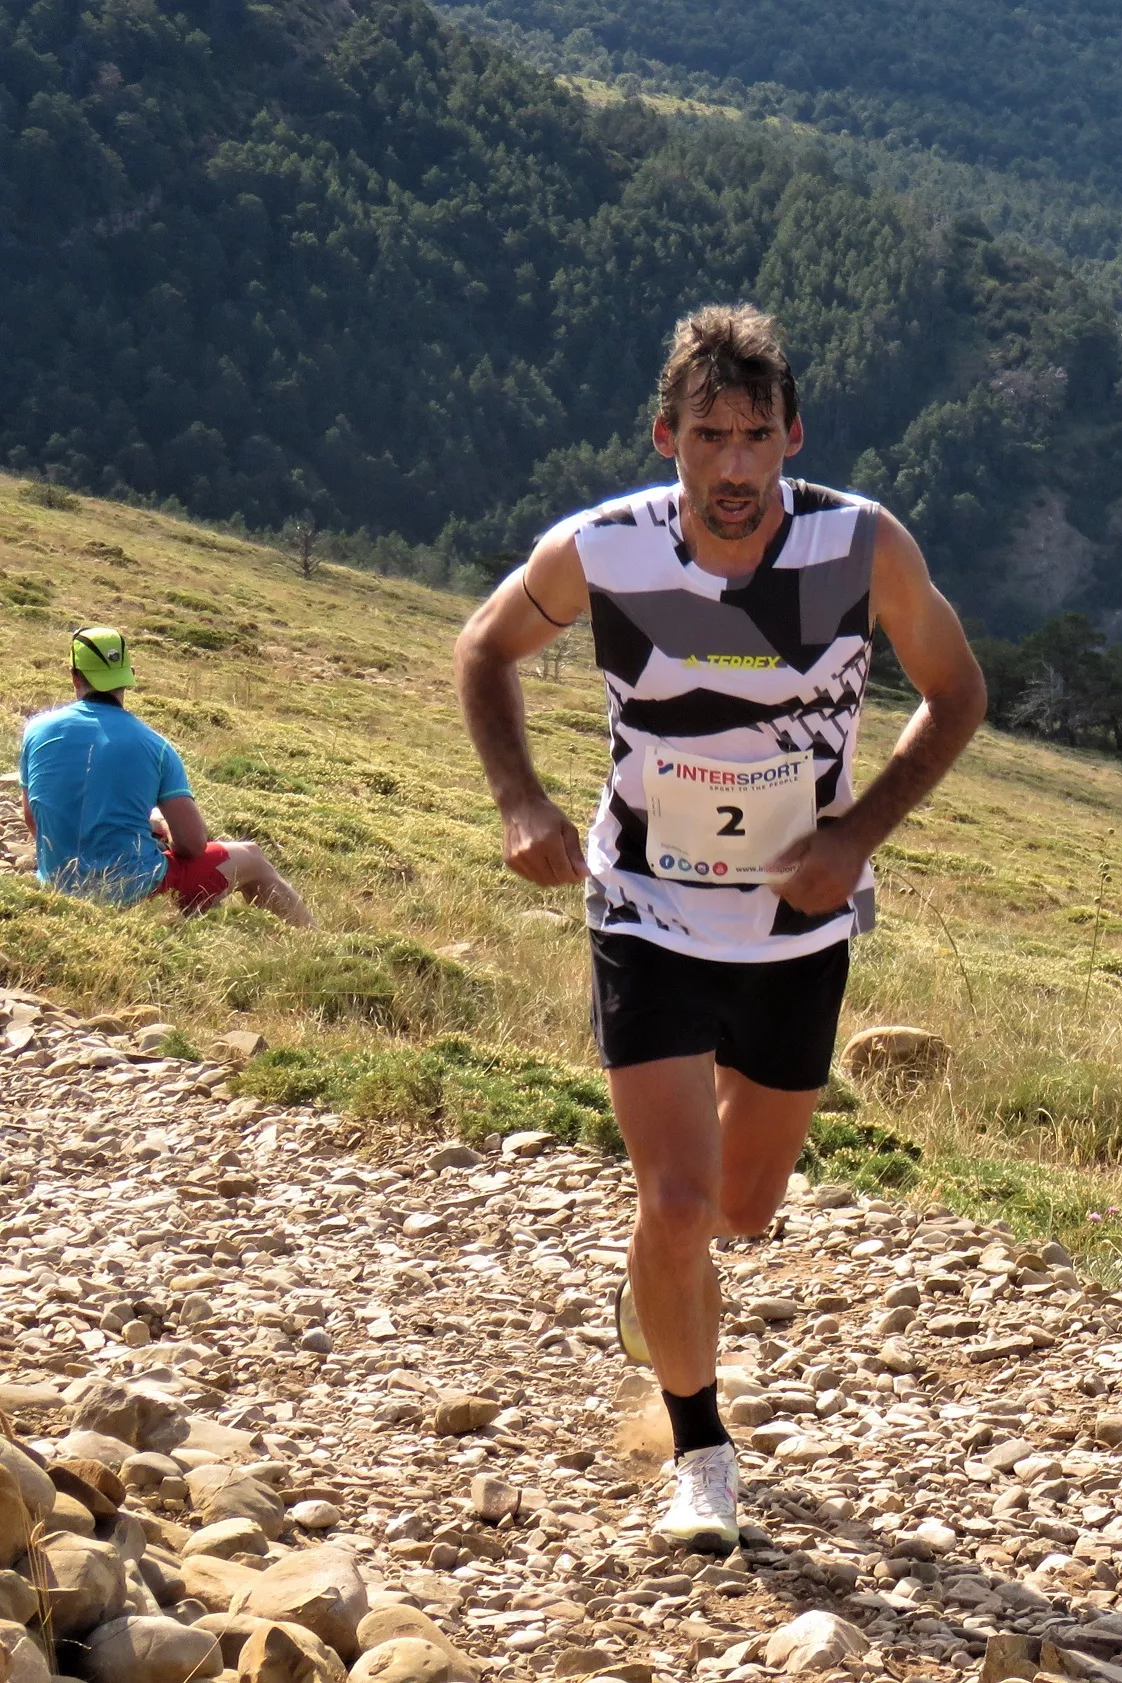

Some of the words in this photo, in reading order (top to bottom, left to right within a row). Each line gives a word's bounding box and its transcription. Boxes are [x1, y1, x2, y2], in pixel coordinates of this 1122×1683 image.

[706, 654, 781, 671] TERREX
[676, 761, 802, 785] INTERSPORT
[769, 776, 799, 788] PEOPLE
[716, 805, 746, 836] 2
